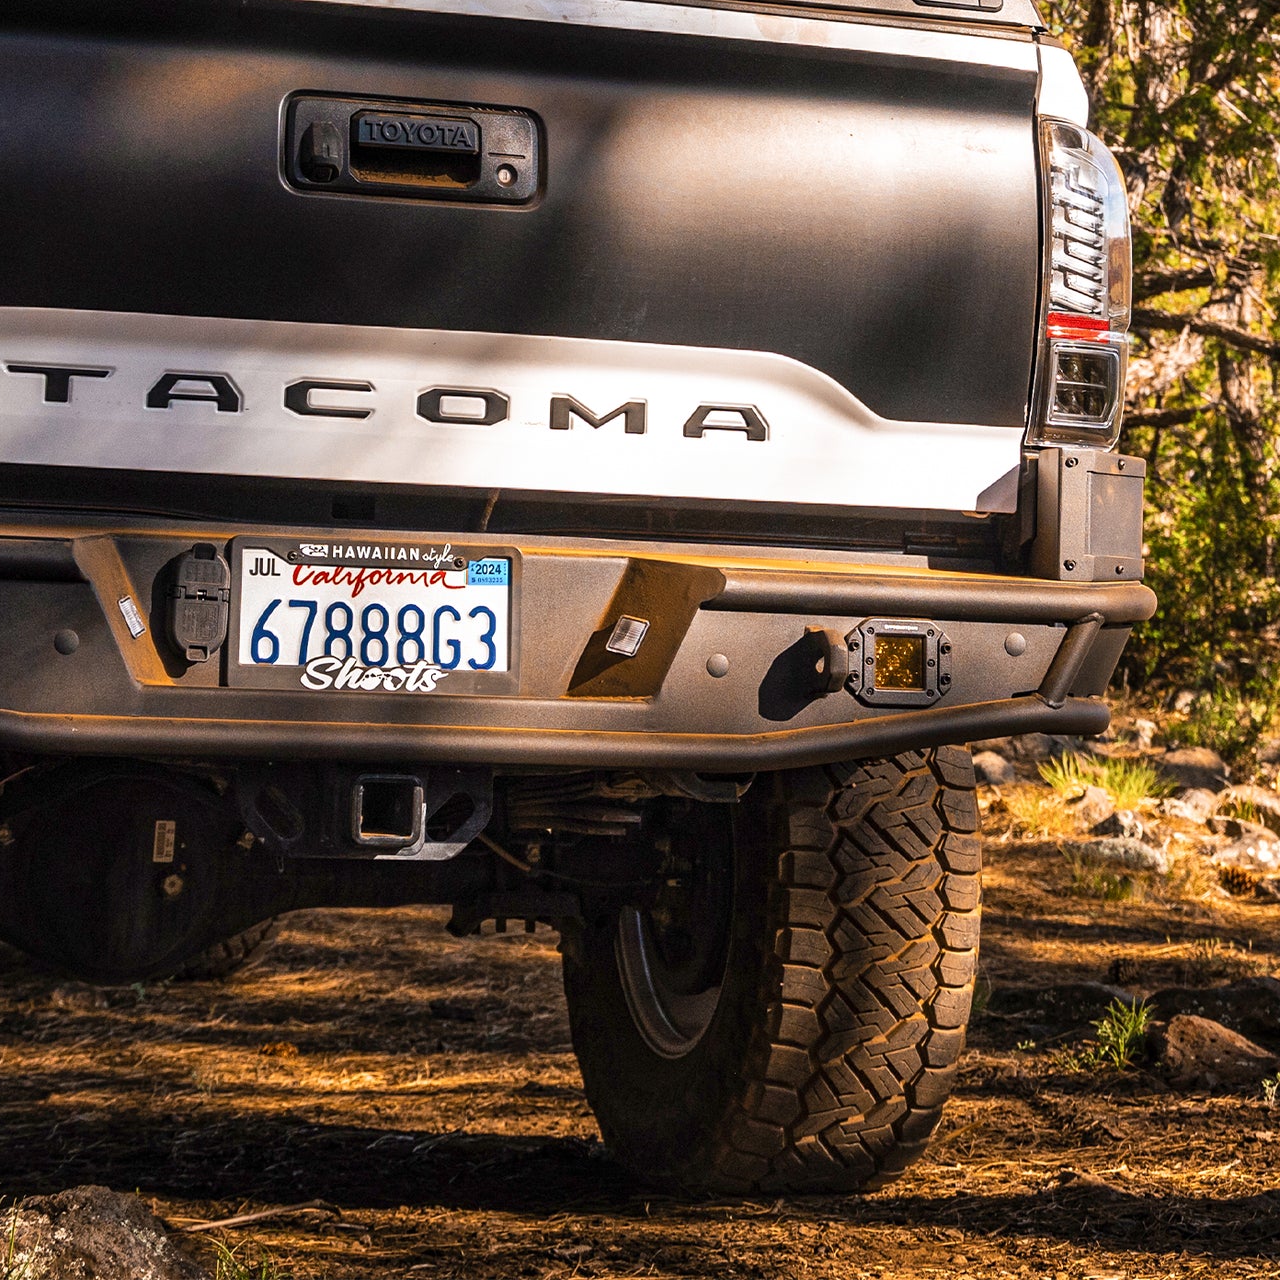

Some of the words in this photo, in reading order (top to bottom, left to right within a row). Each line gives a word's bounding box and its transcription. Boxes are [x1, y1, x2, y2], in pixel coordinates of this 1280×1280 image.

[365, 120, 472, 147] TOYOTA
[5, 361, 770, 442] TACOMA
[249, 557, 281, 577] JUL
[332, 545, 420, 561] HAWAIIAN
[422, 543, 457, 568] style
[475, 564, 502, 575] 2024
[250, 598, 497, 670] 67888G3
[300, 657, 449, 692] Shoots
